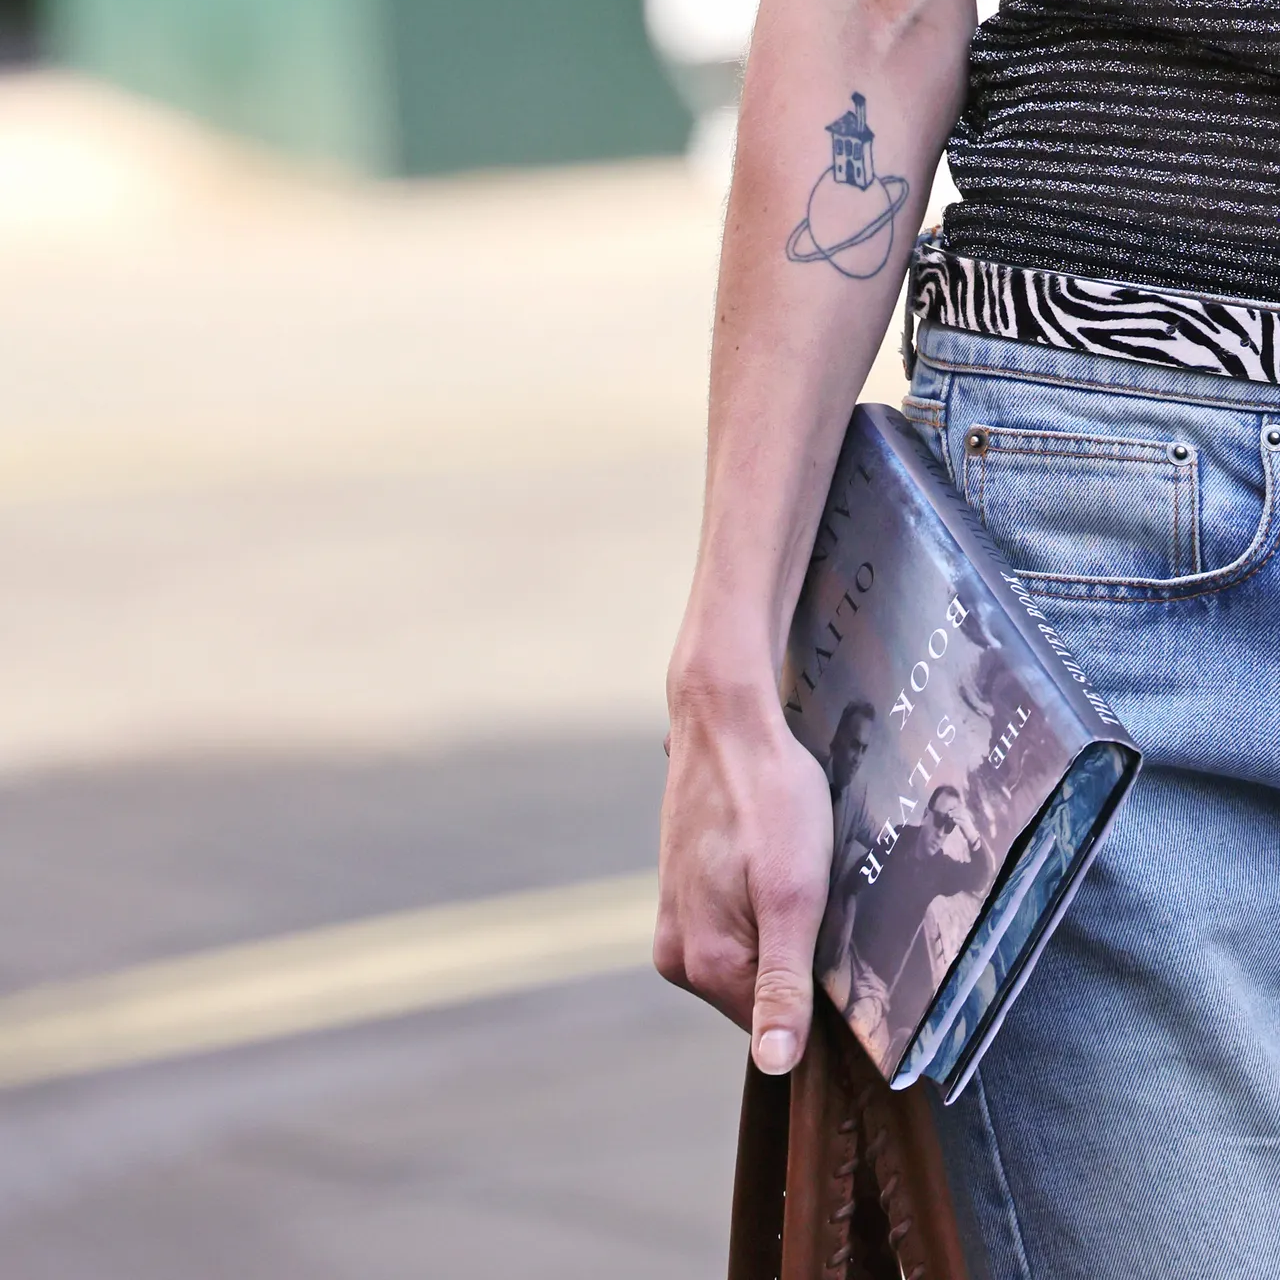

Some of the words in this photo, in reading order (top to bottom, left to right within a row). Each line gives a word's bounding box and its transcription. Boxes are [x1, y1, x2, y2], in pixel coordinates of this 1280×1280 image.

[808, 462, 874, 573] LAIN
[783, 561, 875, 714] OLIVIA
[1000, 570, 1048, 622] BOOK
[889, 593, 970, 732] BOOK
[1037, 623, 1093, 687] SILVER
[988, 704, 1033, 770] THE
[1082, 688, 1121, 727] THE
[858, 714, 957, 886] SILVER
